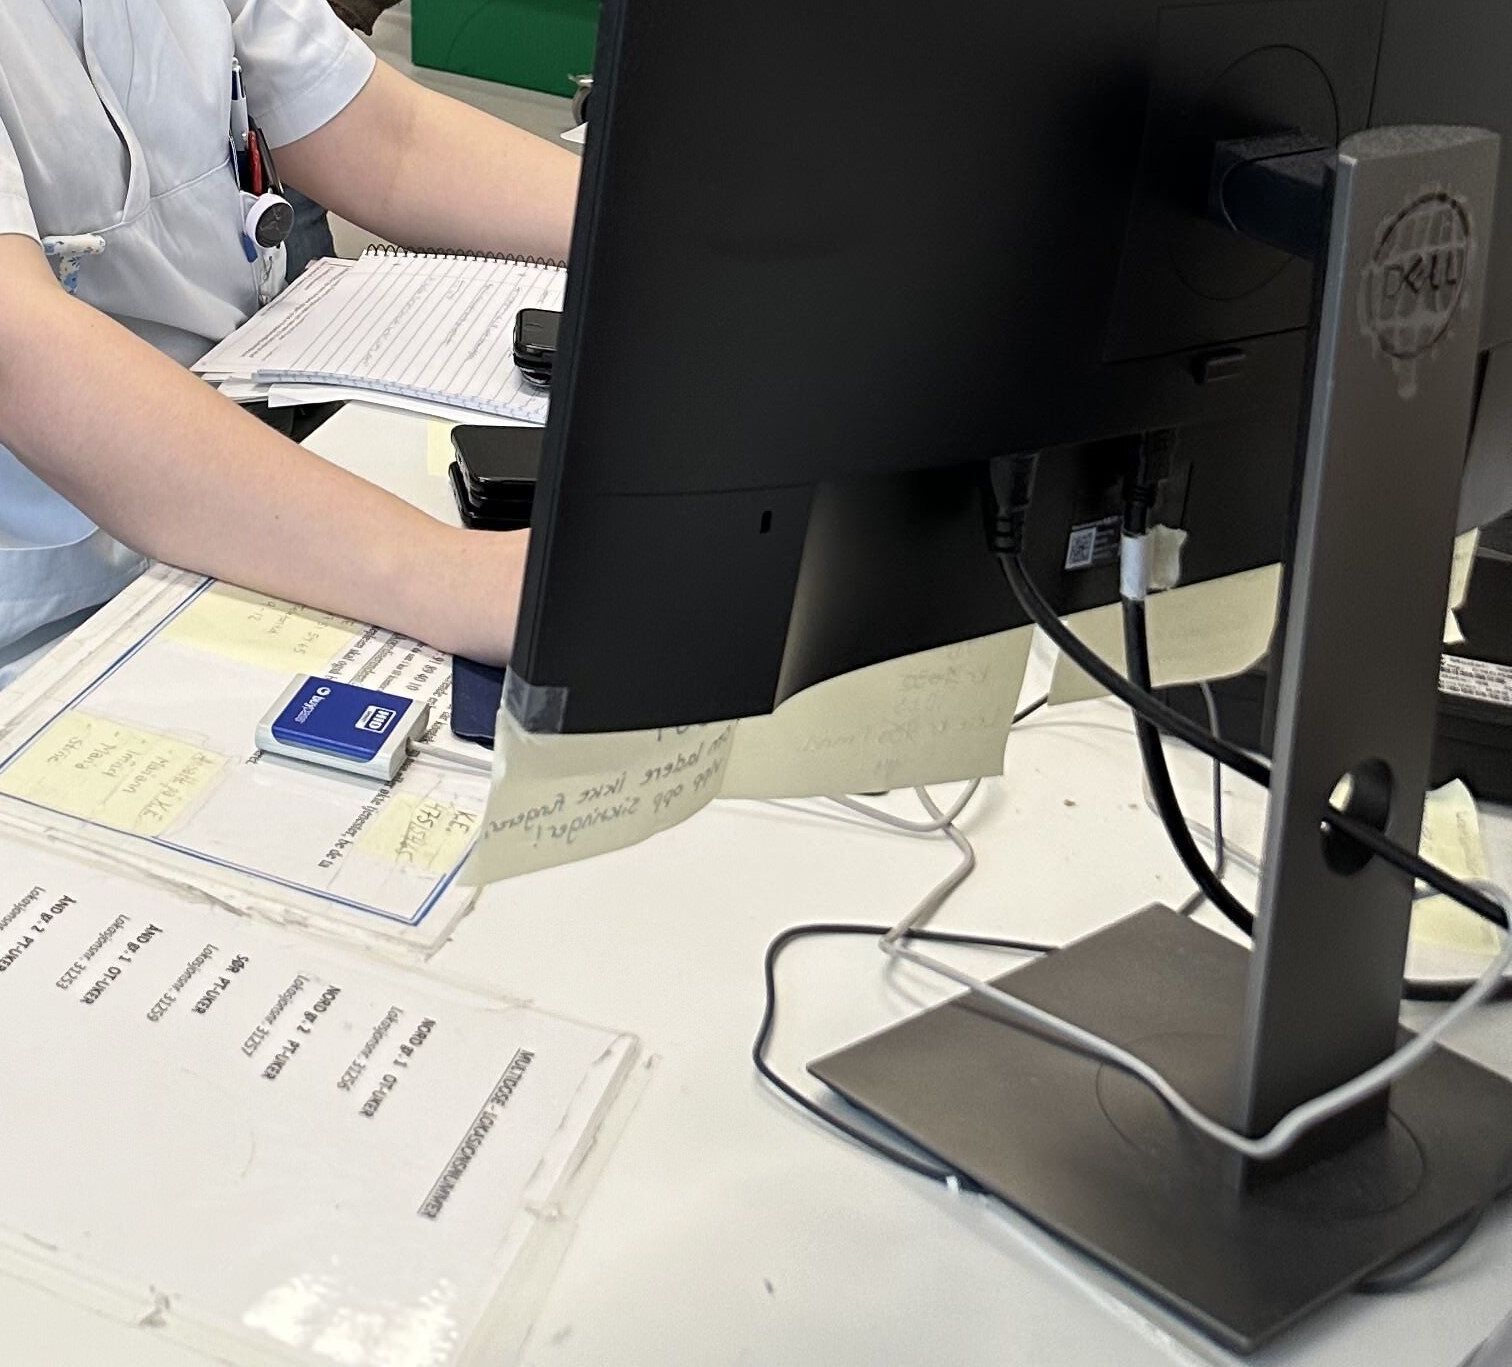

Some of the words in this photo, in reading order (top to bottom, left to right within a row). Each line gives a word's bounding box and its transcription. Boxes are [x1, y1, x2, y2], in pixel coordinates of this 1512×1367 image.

[1382, 252, 1458, 300] DELL
[294, 695, 326, 725] buypass
[369, 710, 390, 730] HID
[48, 895, 77, 915] ÅND
[136, 923, 163, 944] ÅND
[56, 962, 87, 991] 31253
[225, 954, 250, 974] SØR
[80, 966, 122, 1006] OT-UKER
[191, 976, 232, 1015] PT-UKER
[313, 985, 341, 1014] NORD
[147, 993, 176, 1023] 31259
[241, 1025, 270, 1058] 31257
[409, 1017, 436, 1047] NORD
[261, 1040, 300, 1081] PT-UKER
[337, 1059, 366, 1092] 31256
[358, 1074, 398, 1119] OT-UKER
